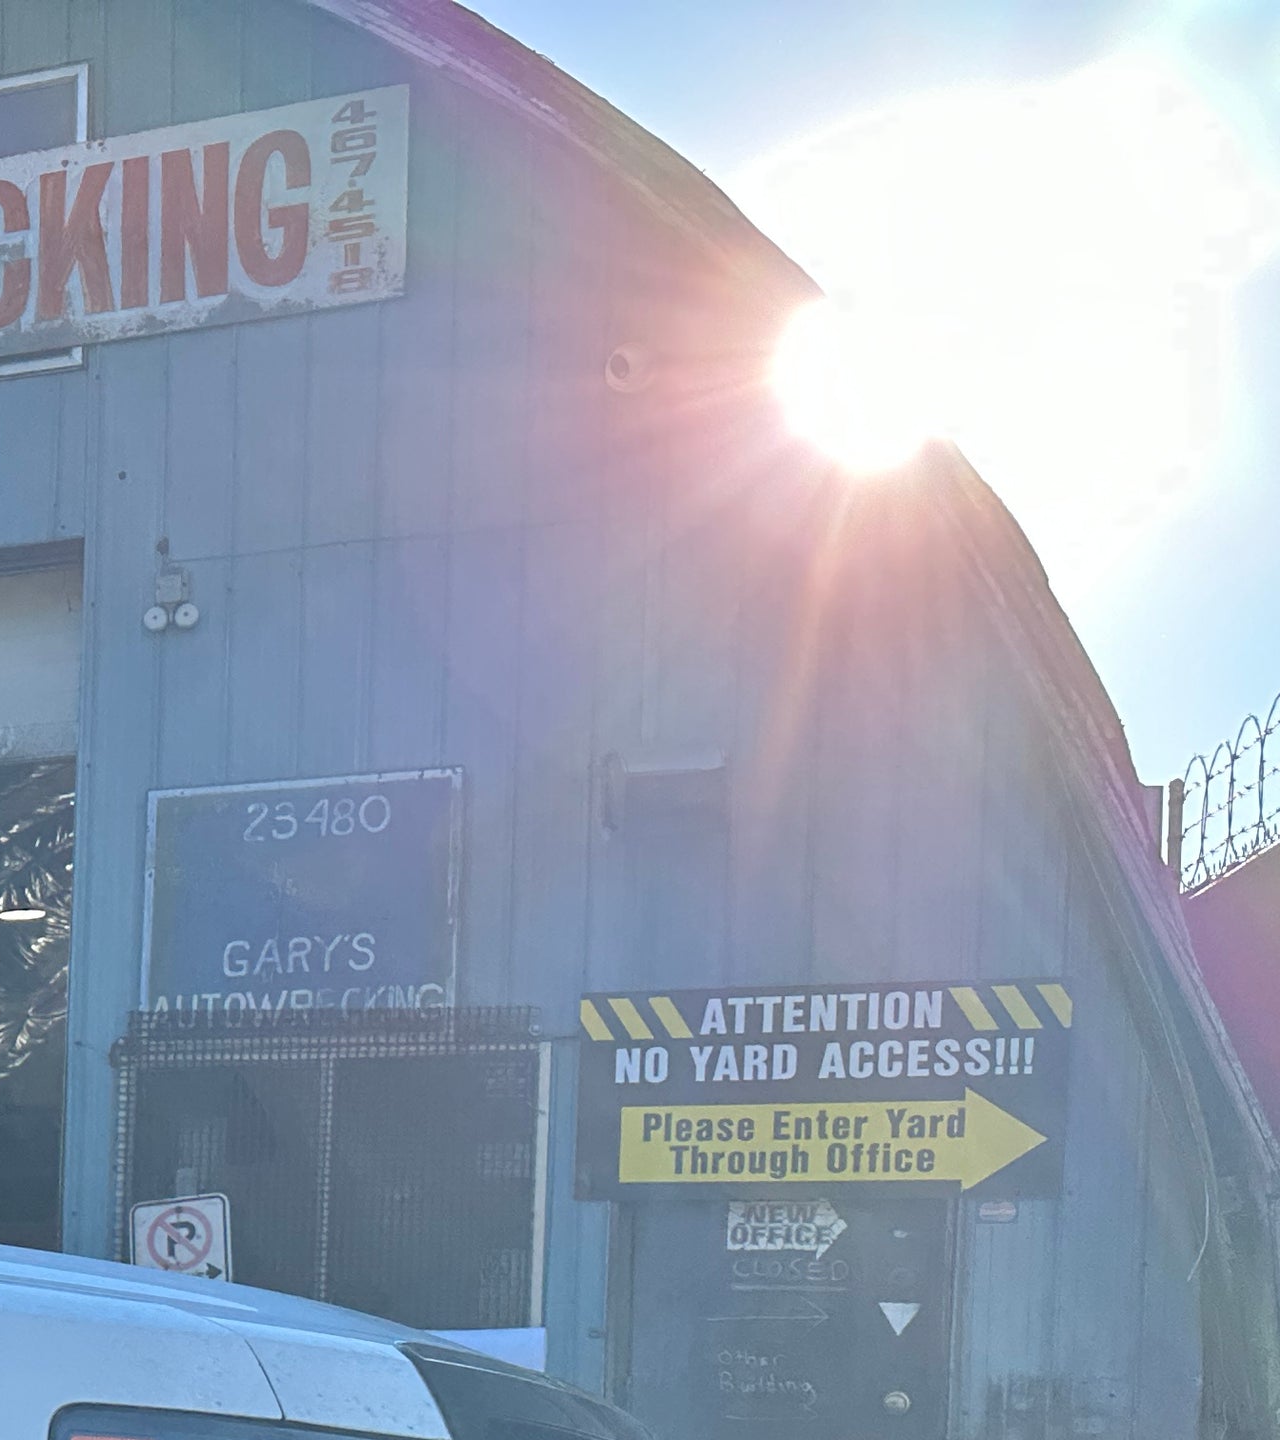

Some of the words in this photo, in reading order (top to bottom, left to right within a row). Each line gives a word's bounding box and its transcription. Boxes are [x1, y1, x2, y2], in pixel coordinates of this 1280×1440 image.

[243, 795, 392, 842] 23480
[223, 932, 377, 978] GARY'S
[699, 990, 942, 1036] ATTENTION
[614, 1046, 669, 1084] NO
[691, 1043, 798, 1082] YARD
[818, 1037, 1035, 1080] ACCESS!!!
[642, 1111, 756, 1144] Please
[772, 1109, 869, 1142] Enter
[885, 1107, 967, 1139] Yard
[668, 1143, 810, 1180] Through
[825, 1142, 936, 1174] Office
[743, 1204, 818, 1223] NEW
[730, 1224, 833, 1246] OFFICE
[732, 1258, 849, 1281] CLOSED
